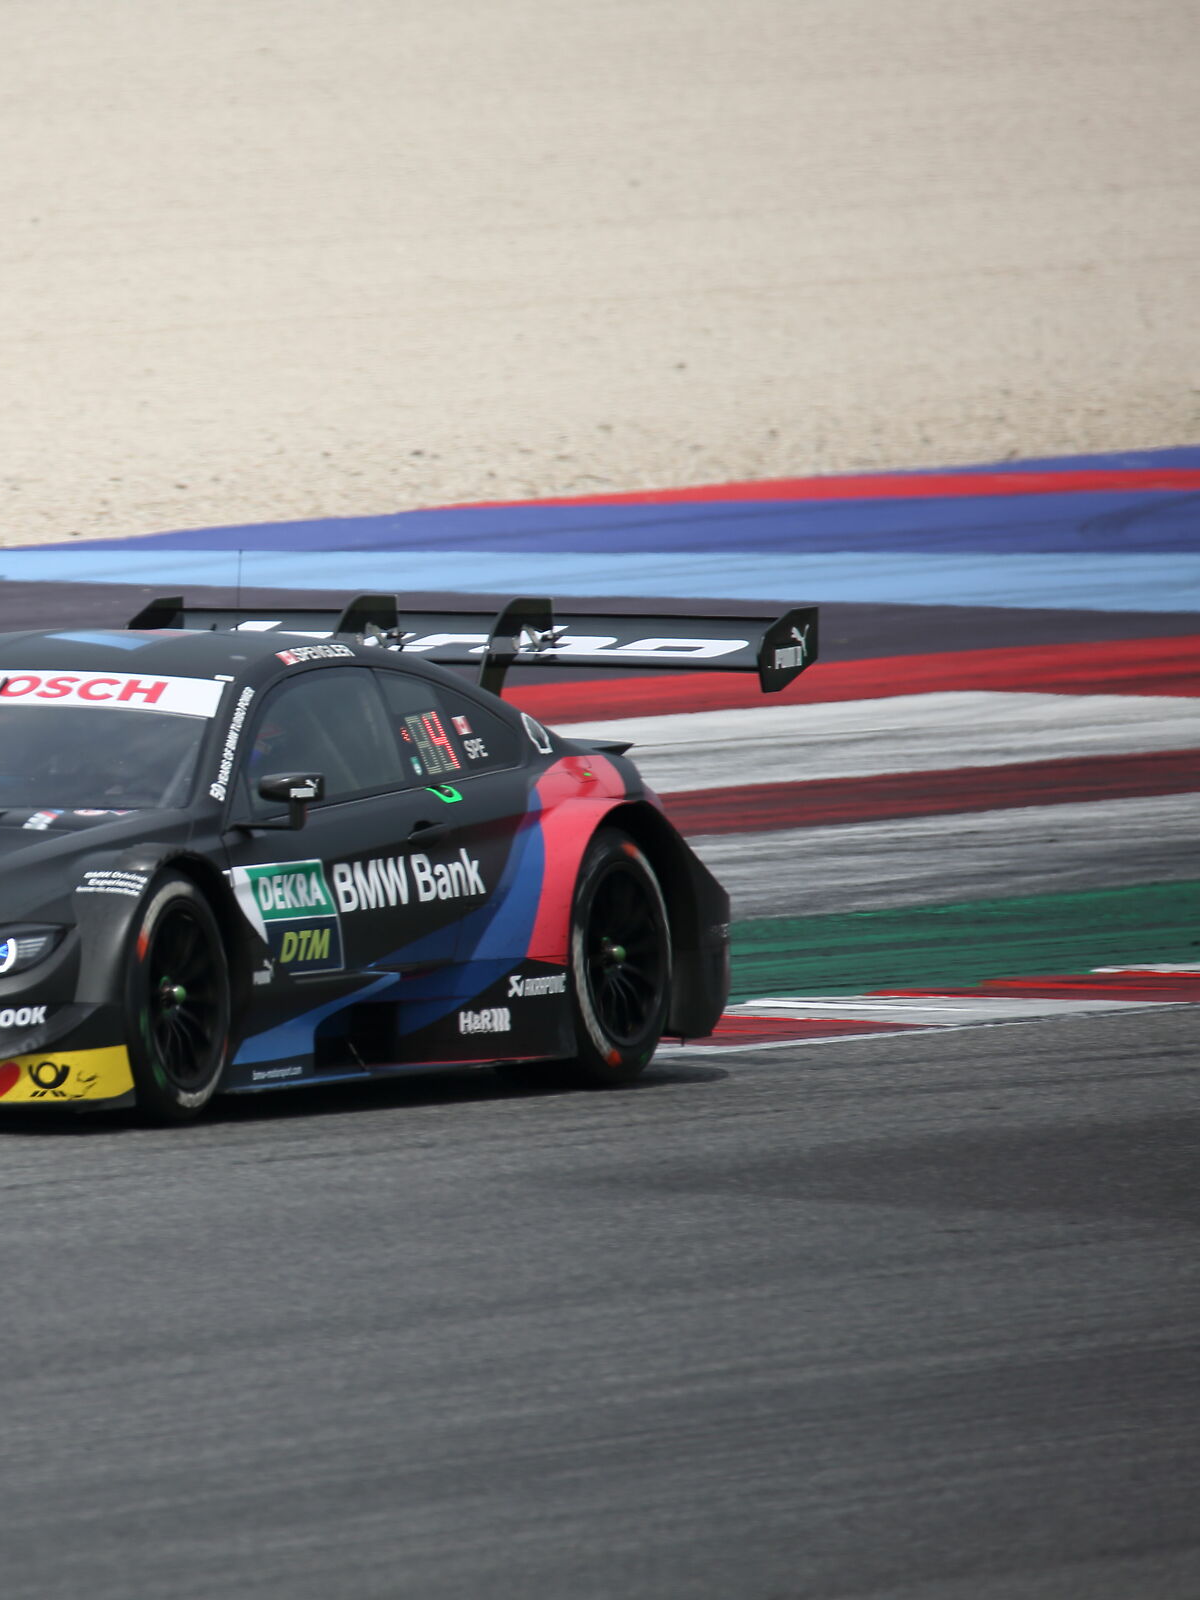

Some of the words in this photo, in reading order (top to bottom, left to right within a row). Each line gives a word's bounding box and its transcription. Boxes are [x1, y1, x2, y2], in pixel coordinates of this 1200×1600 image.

[222, 747, 234, 761] OF
[464, 738, 489, 760] SPE
[217, 758, 232, 785] YEARS
[209, 782, 226, 801] 50
[257, 872, 328, 911] DEKRA
[333, 855, 408, 914] BMW
[411, 848, 487, 903] Bank
[280, 929, 330, 964] DTM
